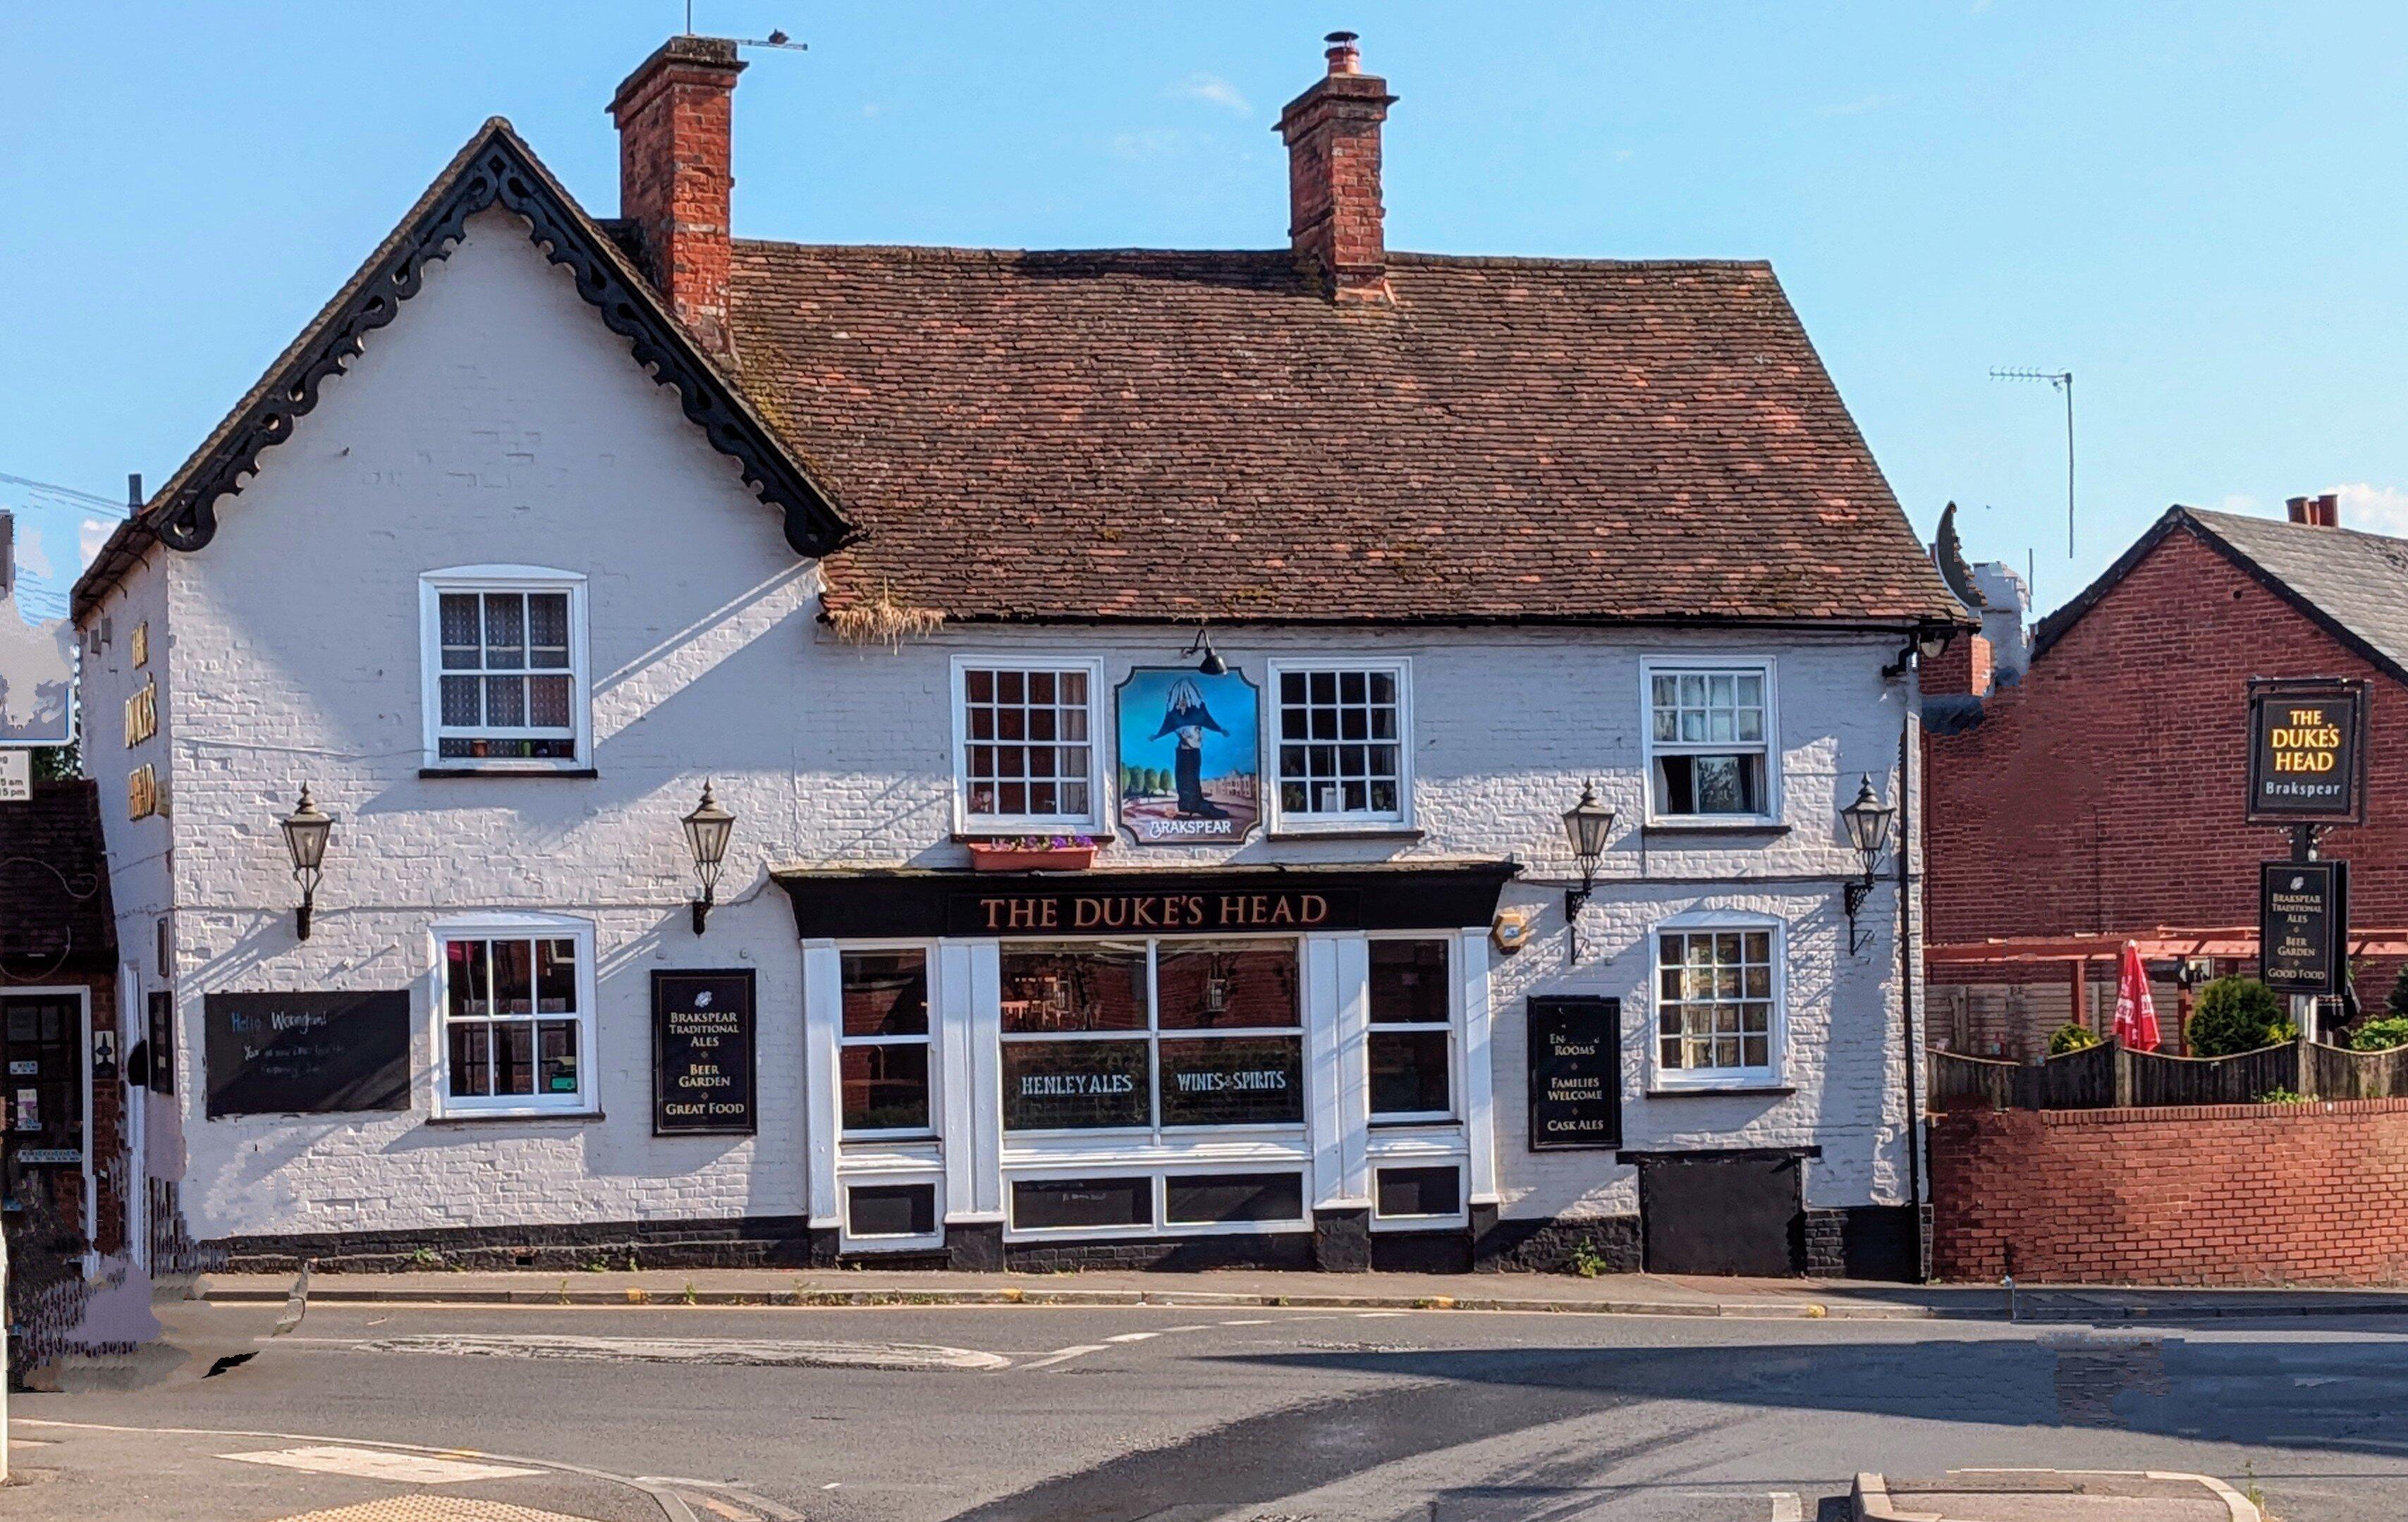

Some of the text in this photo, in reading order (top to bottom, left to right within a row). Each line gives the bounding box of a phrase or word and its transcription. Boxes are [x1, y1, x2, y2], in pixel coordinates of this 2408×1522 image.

[2290, 710, 2323, 725] THE
[2272, 723, 2340, 748] DUKE'S
[2275, 751, 2334, 771] HEAD
[11, 789, 25, 797] pm
[2266, 782, 2340, 797] Brakspear
[1149, 820, 1232, 838] BRAKSPEAR
[981, 895, 1326, 927] THE DUKE'S HEAD
[2278, 945, 2315, 957] GARDEN
[2268, 968, 2297, 978] GOOD
[671, 1012, 738, 1023] BRAKSPEAR
[669, 1024, 740, 1034] TRADITIONAL
[690, 1036, 719, 1047] ALES
[1554, 1045, 1596, 1056] ROOMS
[690, 1064, 719, 1075] BEER
[678, 1076, 731, 1087] GARDEN
[1022, 1074, 1133, 1094] HENLEY ALES
[1551, 1077, 1599, 1088] FAMILIES
[1548, 1091, 1602, 1101] WELCOME
[666, 1103, 745, 1115] GREAT FOOD
[1547, 1119, 1603, 1131] CASK ALES
